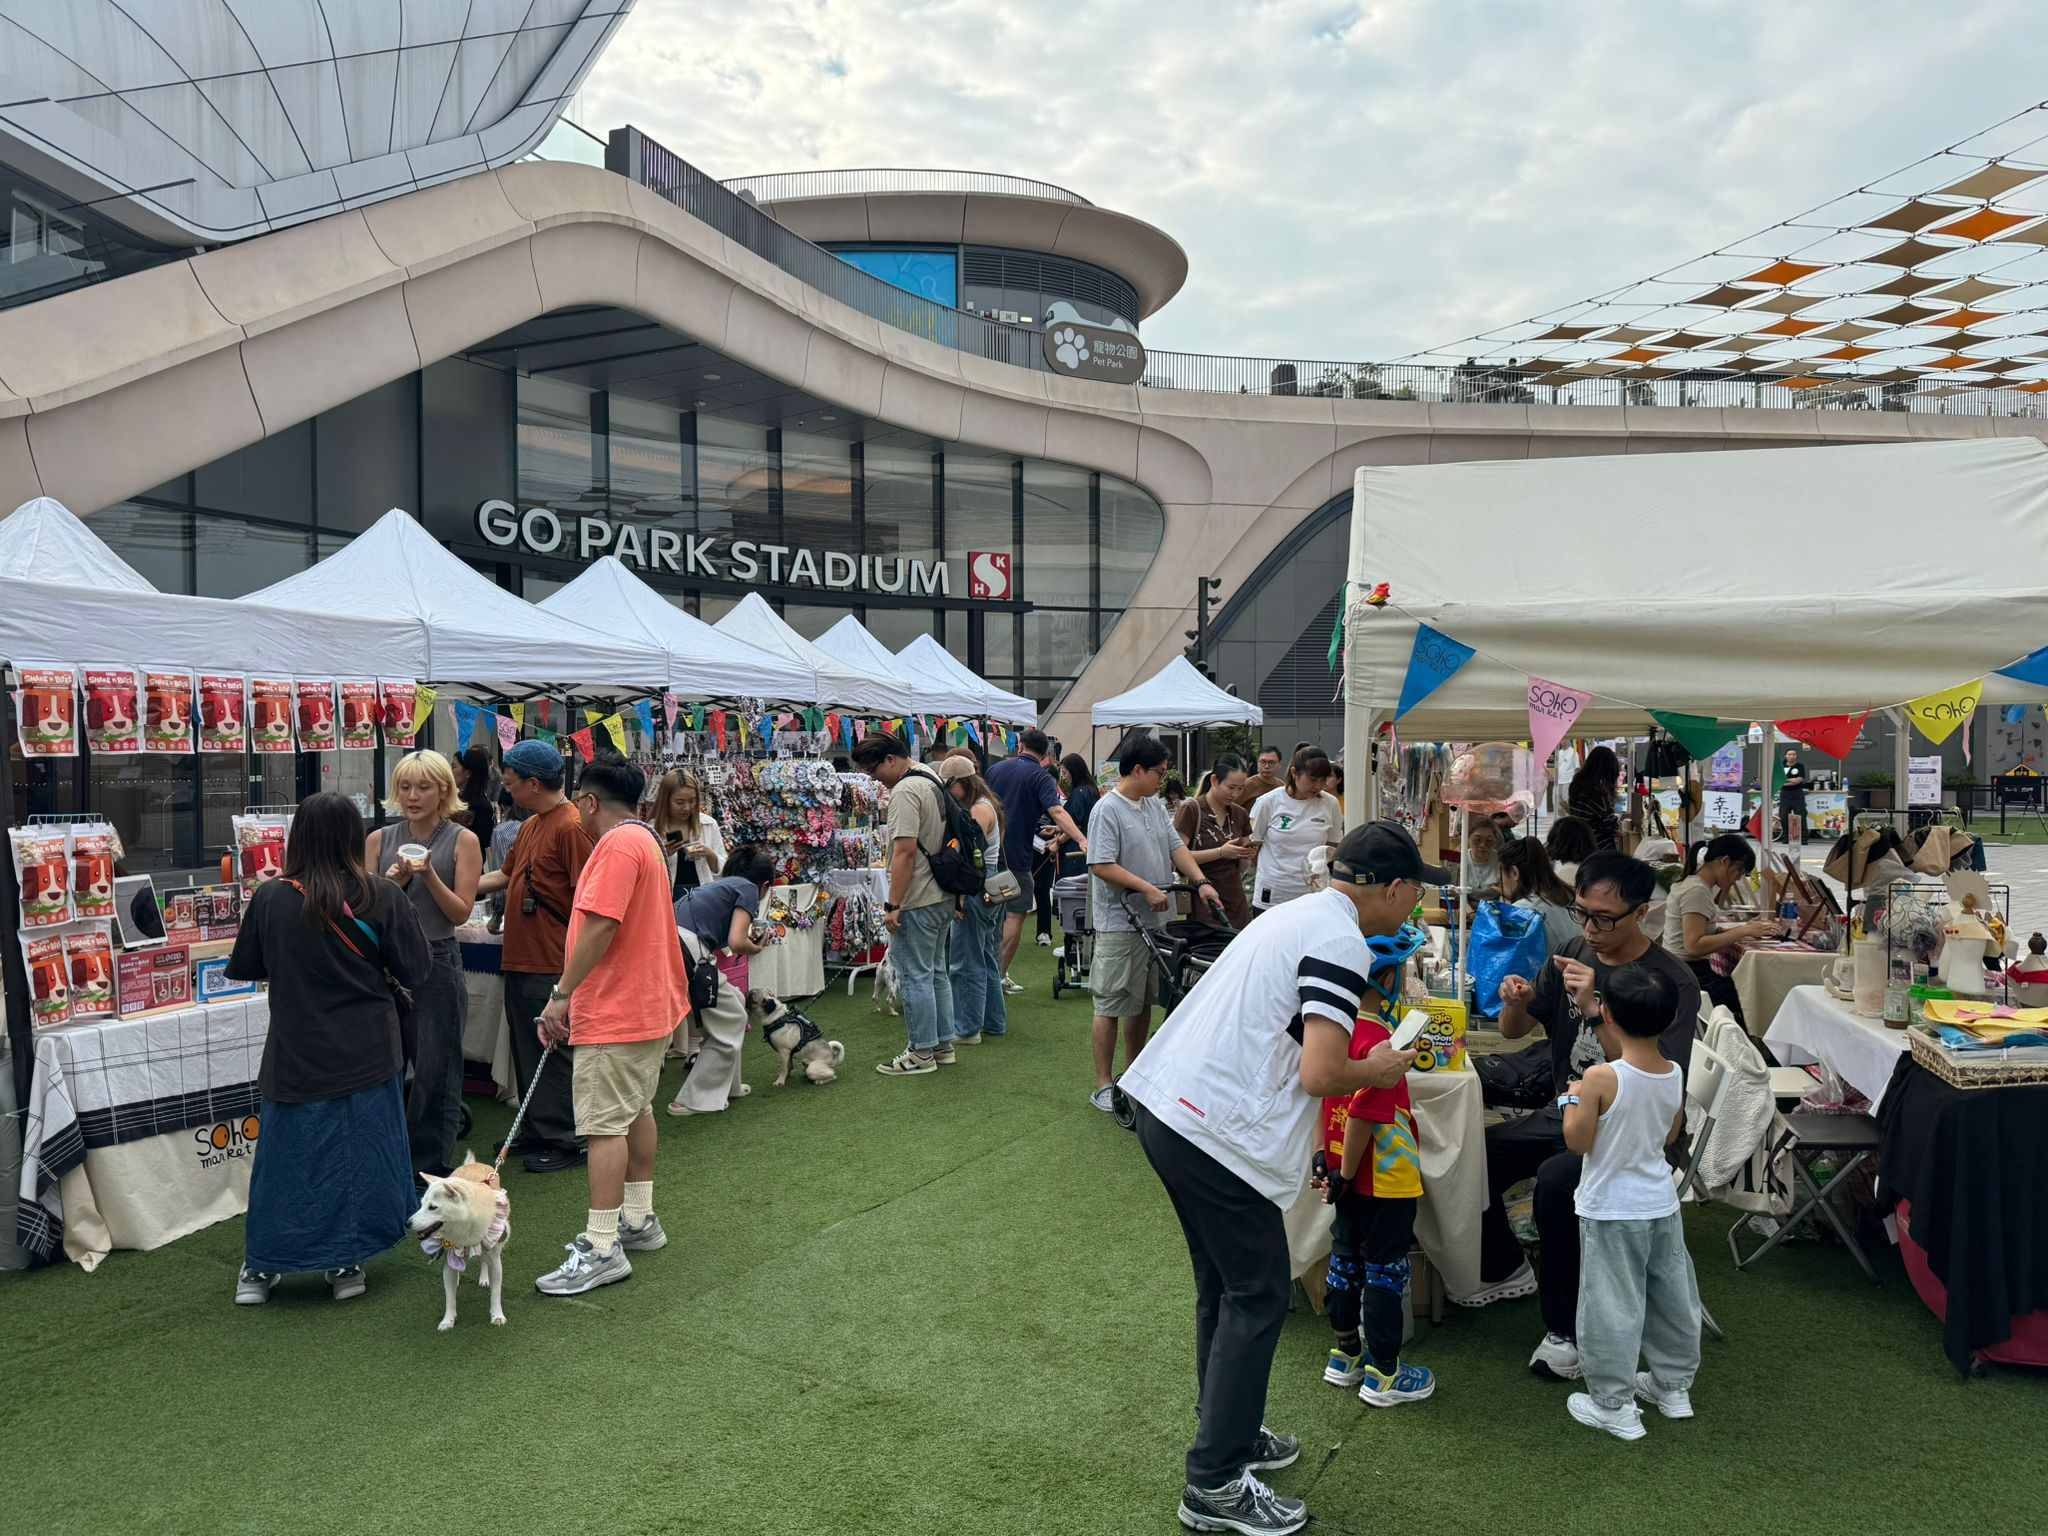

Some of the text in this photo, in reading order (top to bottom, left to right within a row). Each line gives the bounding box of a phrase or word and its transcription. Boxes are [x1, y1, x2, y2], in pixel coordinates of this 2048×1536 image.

[1093, 356, 1124, 369] Pet Park
[477, 499, 950, 595] GO PARK STADIUM
[200, 1143, 252, 1169] market
